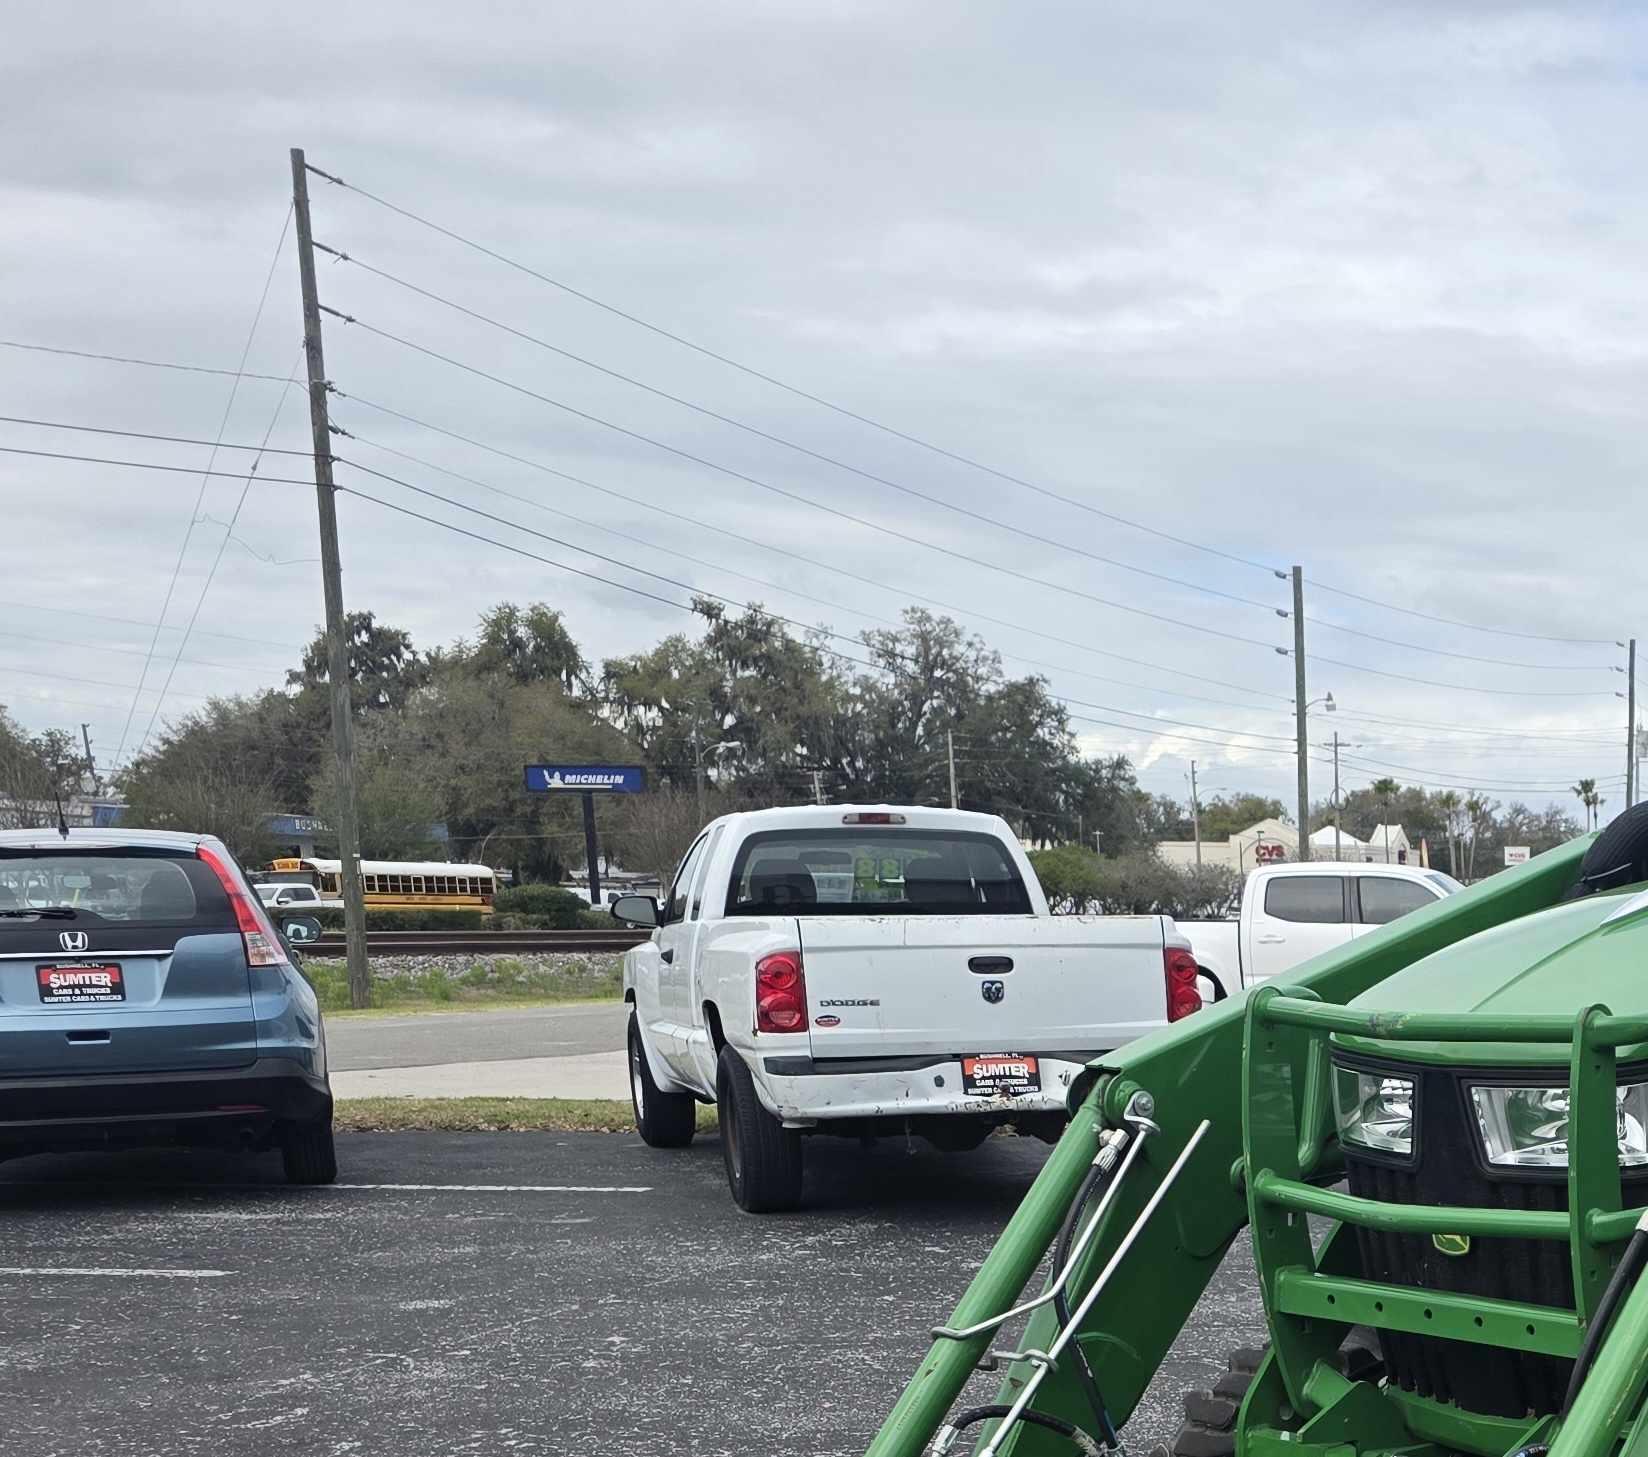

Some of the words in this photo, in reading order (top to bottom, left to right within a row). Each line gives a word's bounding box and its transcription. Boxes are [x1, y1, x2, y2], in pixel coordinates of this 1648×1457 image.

[564, 774, 624, 784] MICHELIN
[1255, 844, 1285, 858] CVS
[49, 972, 113, 989] SUMTER
[82, 987, 111, 995] TRUCKS
[819, 999, 881, 1007] DODGE
[973, 1063, 1030, 1080] SUMTER
[975, 1079, 995, 1087] CARS
